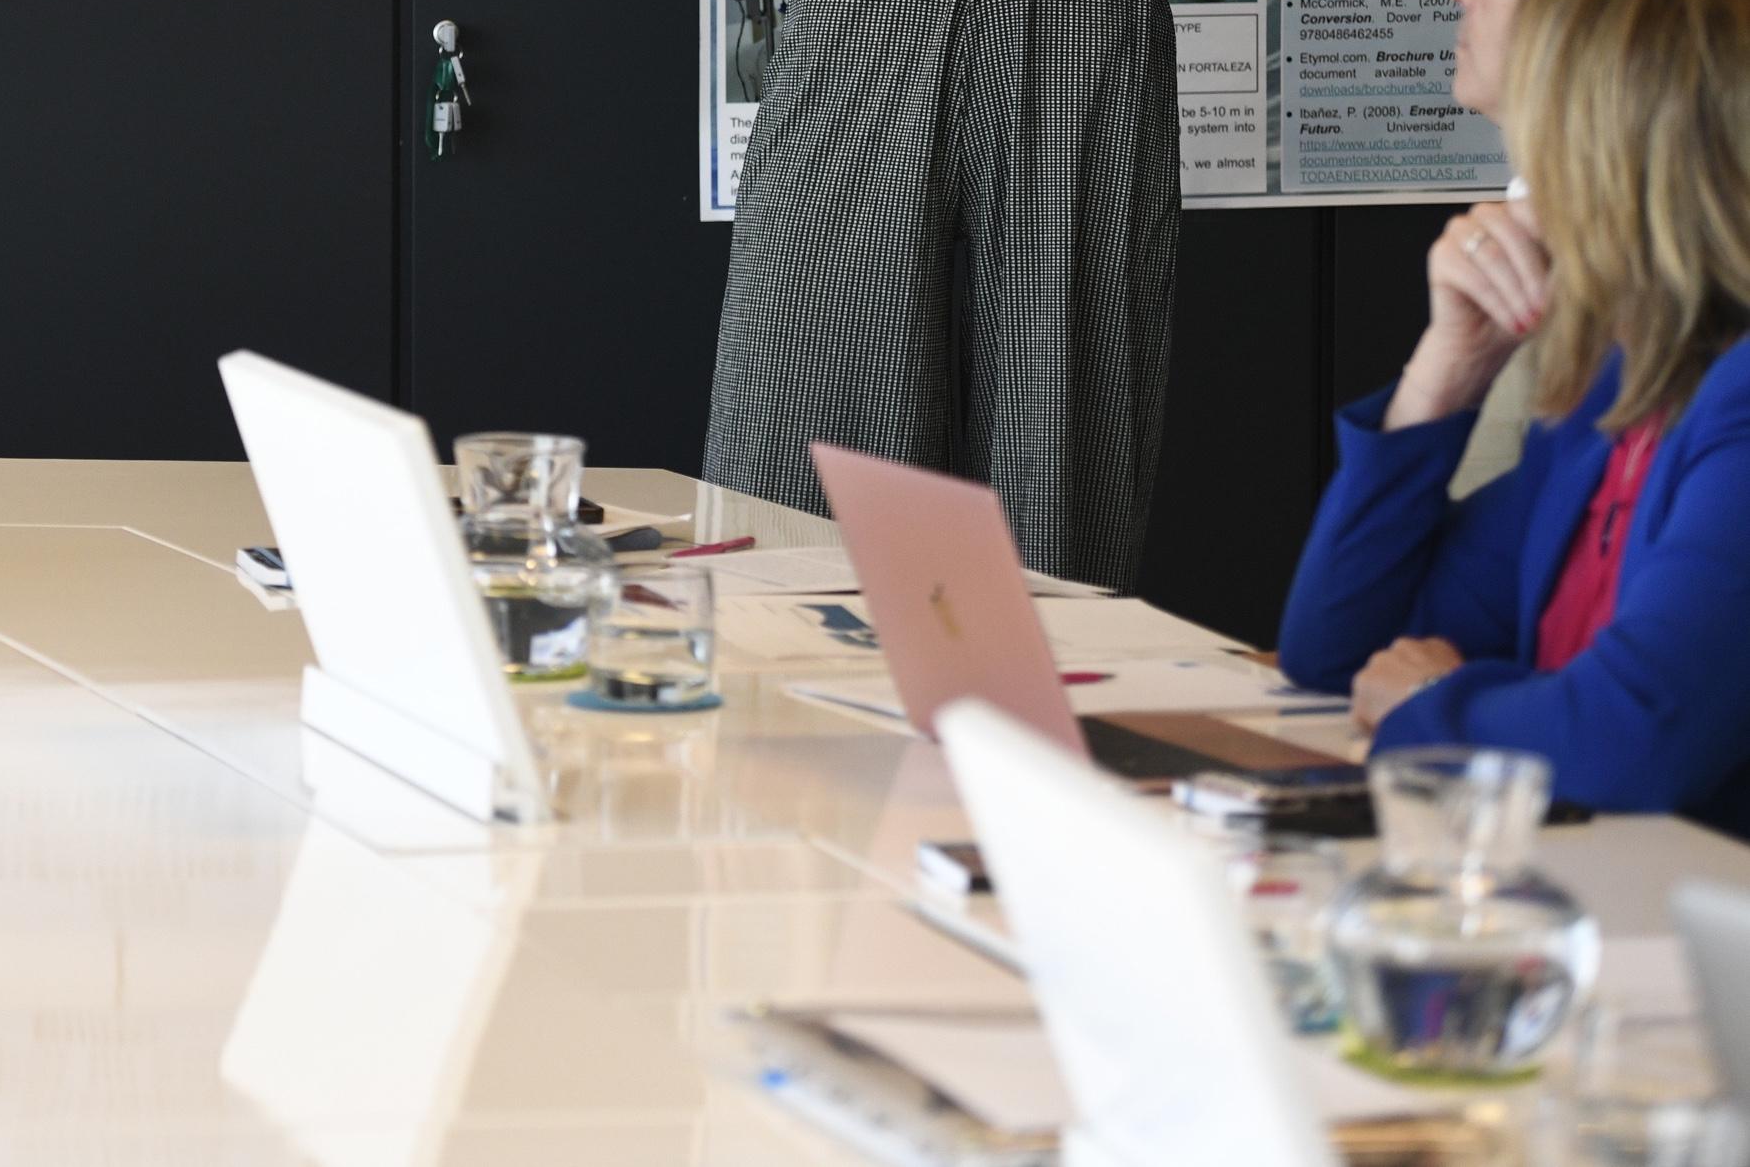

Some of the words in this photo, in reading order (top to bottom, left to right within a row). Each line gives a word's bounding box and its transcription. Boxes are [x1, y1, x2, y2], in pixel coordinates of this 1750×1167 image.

[1387, 12, 1422, 23] Dover
[1300, 28, 1394, 41] 9780486462455
[1376, 51, 1435, 62] Brochure
[1189, 62, 1252, 73] FORTALEZA
[1300, 68, 1356, 80] document
[1375, 67, 1426, 78] available
[1387, 121, 1455, 133] Universidad
